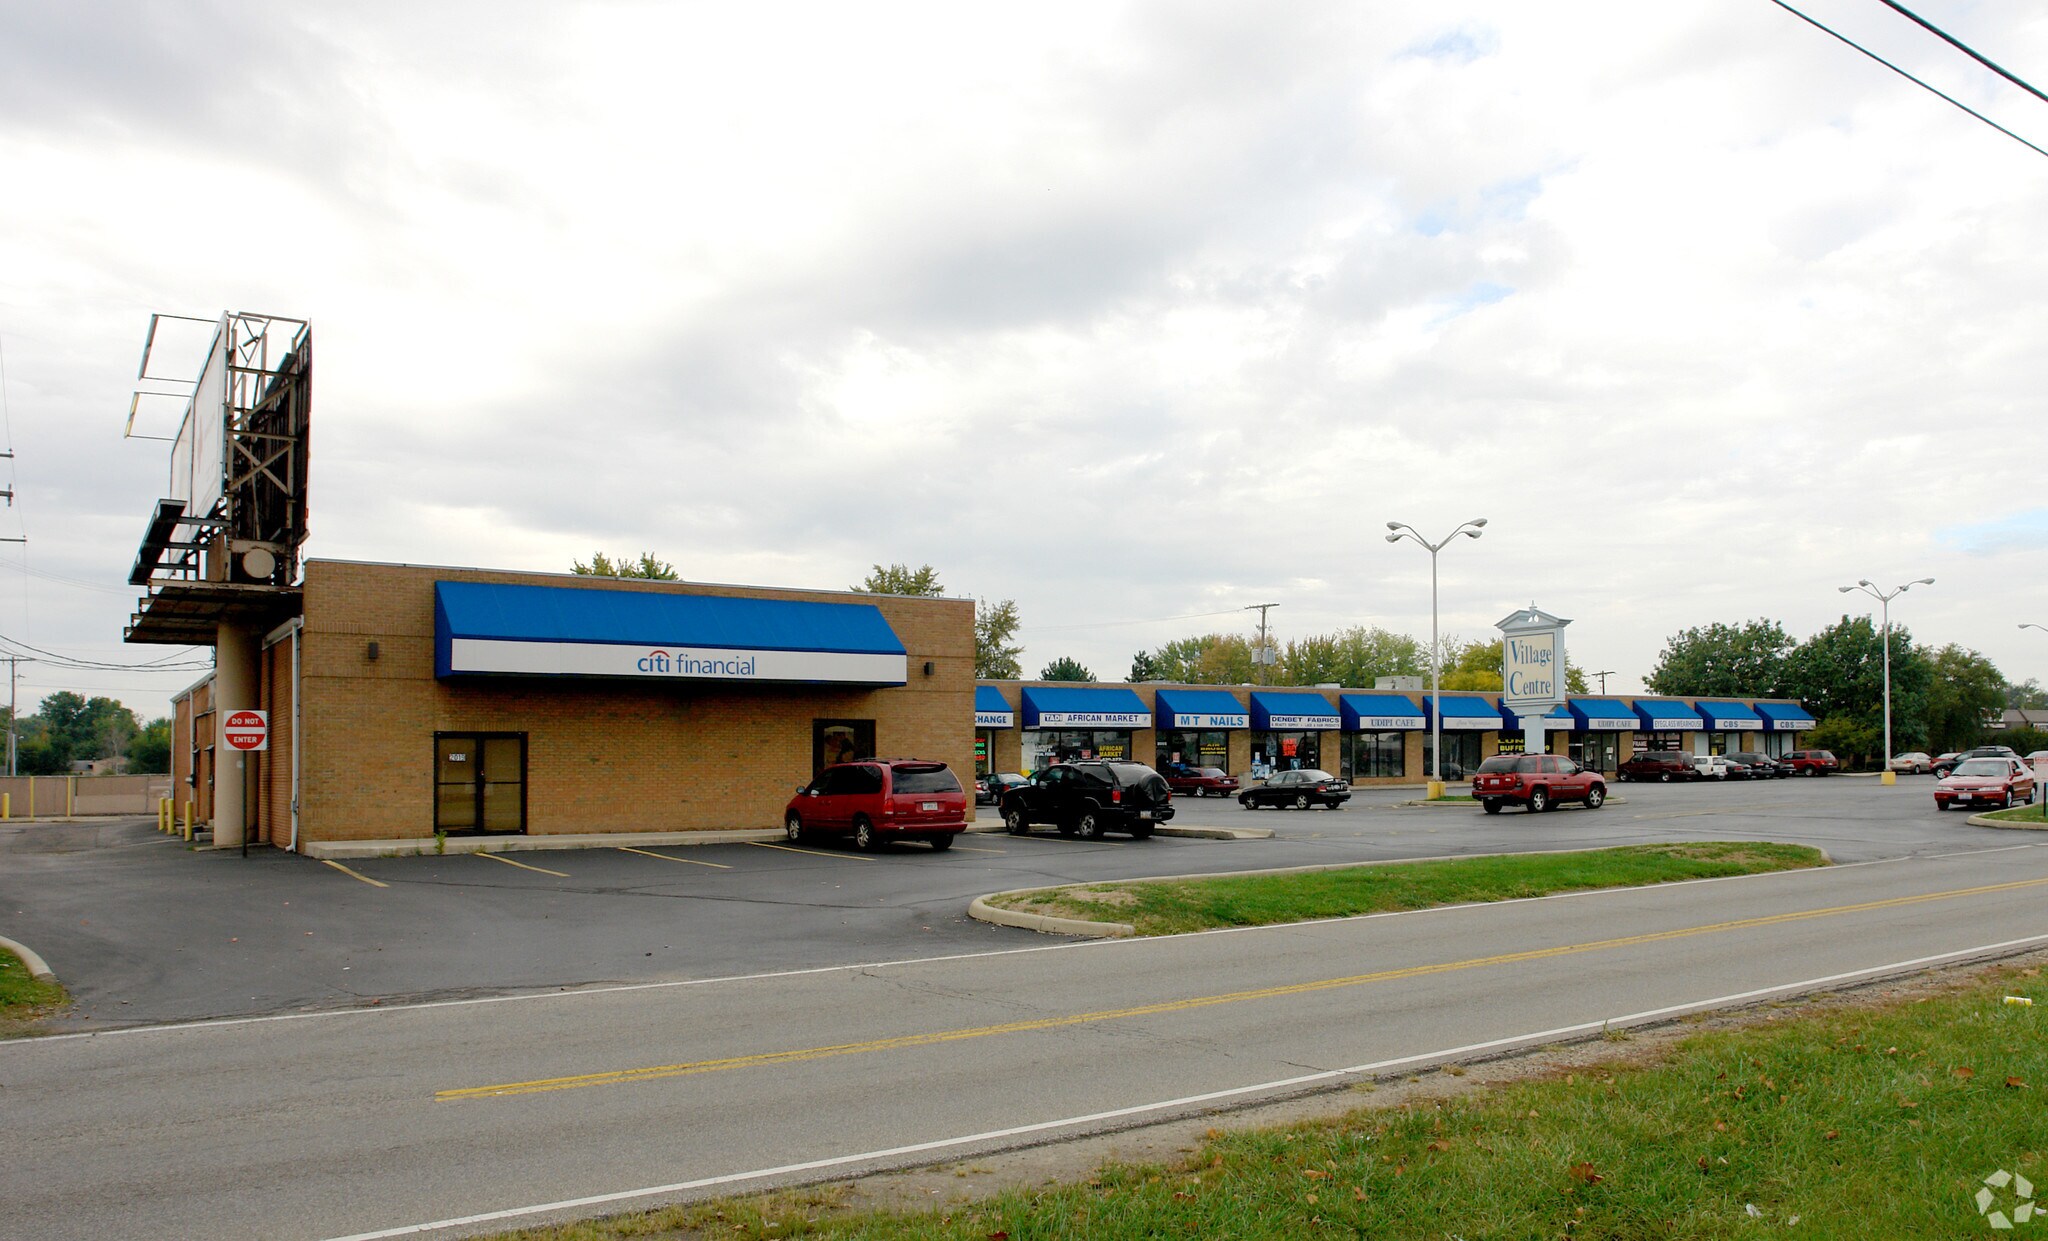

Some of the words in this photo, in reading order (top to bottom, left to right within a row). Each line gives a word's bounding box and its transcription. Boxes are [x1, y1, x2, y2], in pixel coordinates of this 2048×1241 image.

[1510, 640, 1552, 667] Village
[637, 652, 670, 672] citi
[676, 654, 755, 675] financial
[1509, 671, 1551, 696] Centre
[1067, 714, 1102, 722] AFRICAN
[1209, 716, 1244, 726] NAILS
[1370, 719, 1393, 727] UDIPI
[1395, 719, 1416, 727] CAFE
[1616, 720, 1632, 728] CAFE
